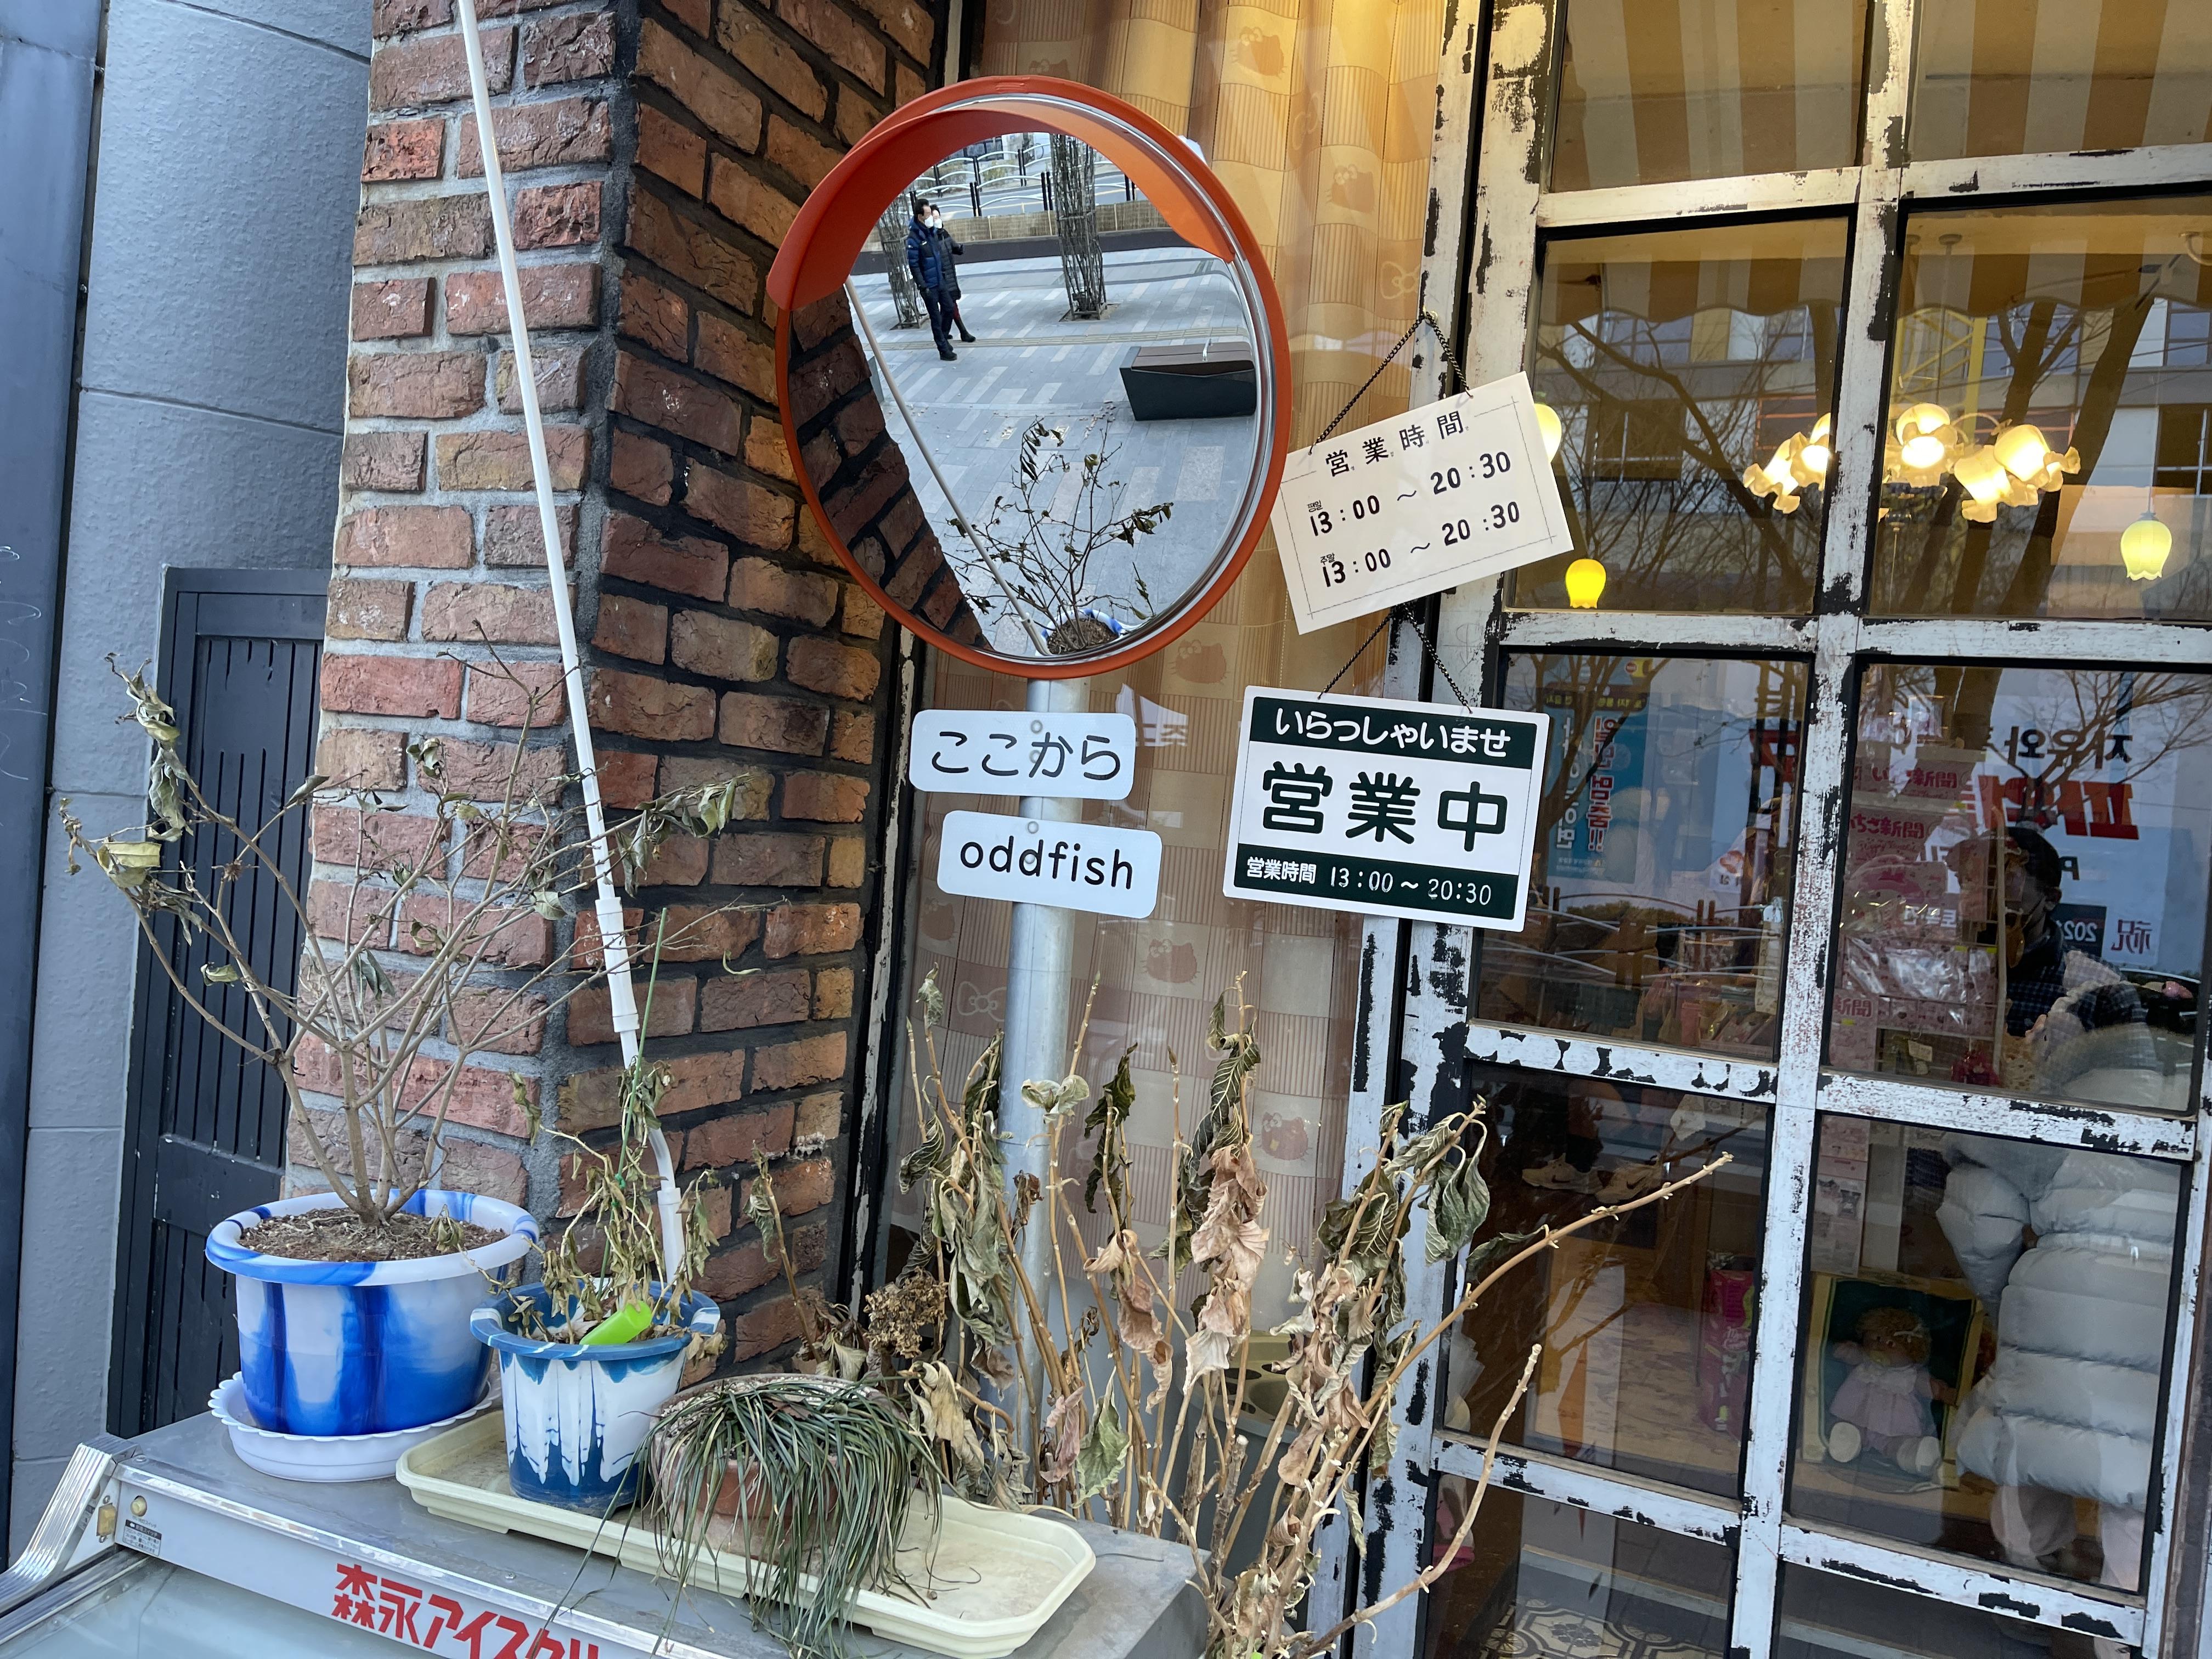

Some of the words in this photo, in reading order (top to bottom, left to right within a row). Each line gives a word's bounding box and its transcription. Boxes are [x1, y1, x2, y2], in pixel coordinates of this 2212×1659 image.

[1325, 410, 1464, 477] 営業時間
[932, 731, 1120, 780] ここから
[1276, 708, 1511, 758] いらっしゃいませ
[1262, 761, 1508, 852] 営業中
[960, 836, 1133, 890] oddfish
[1246, 856, 1317, 884] 営業時間
